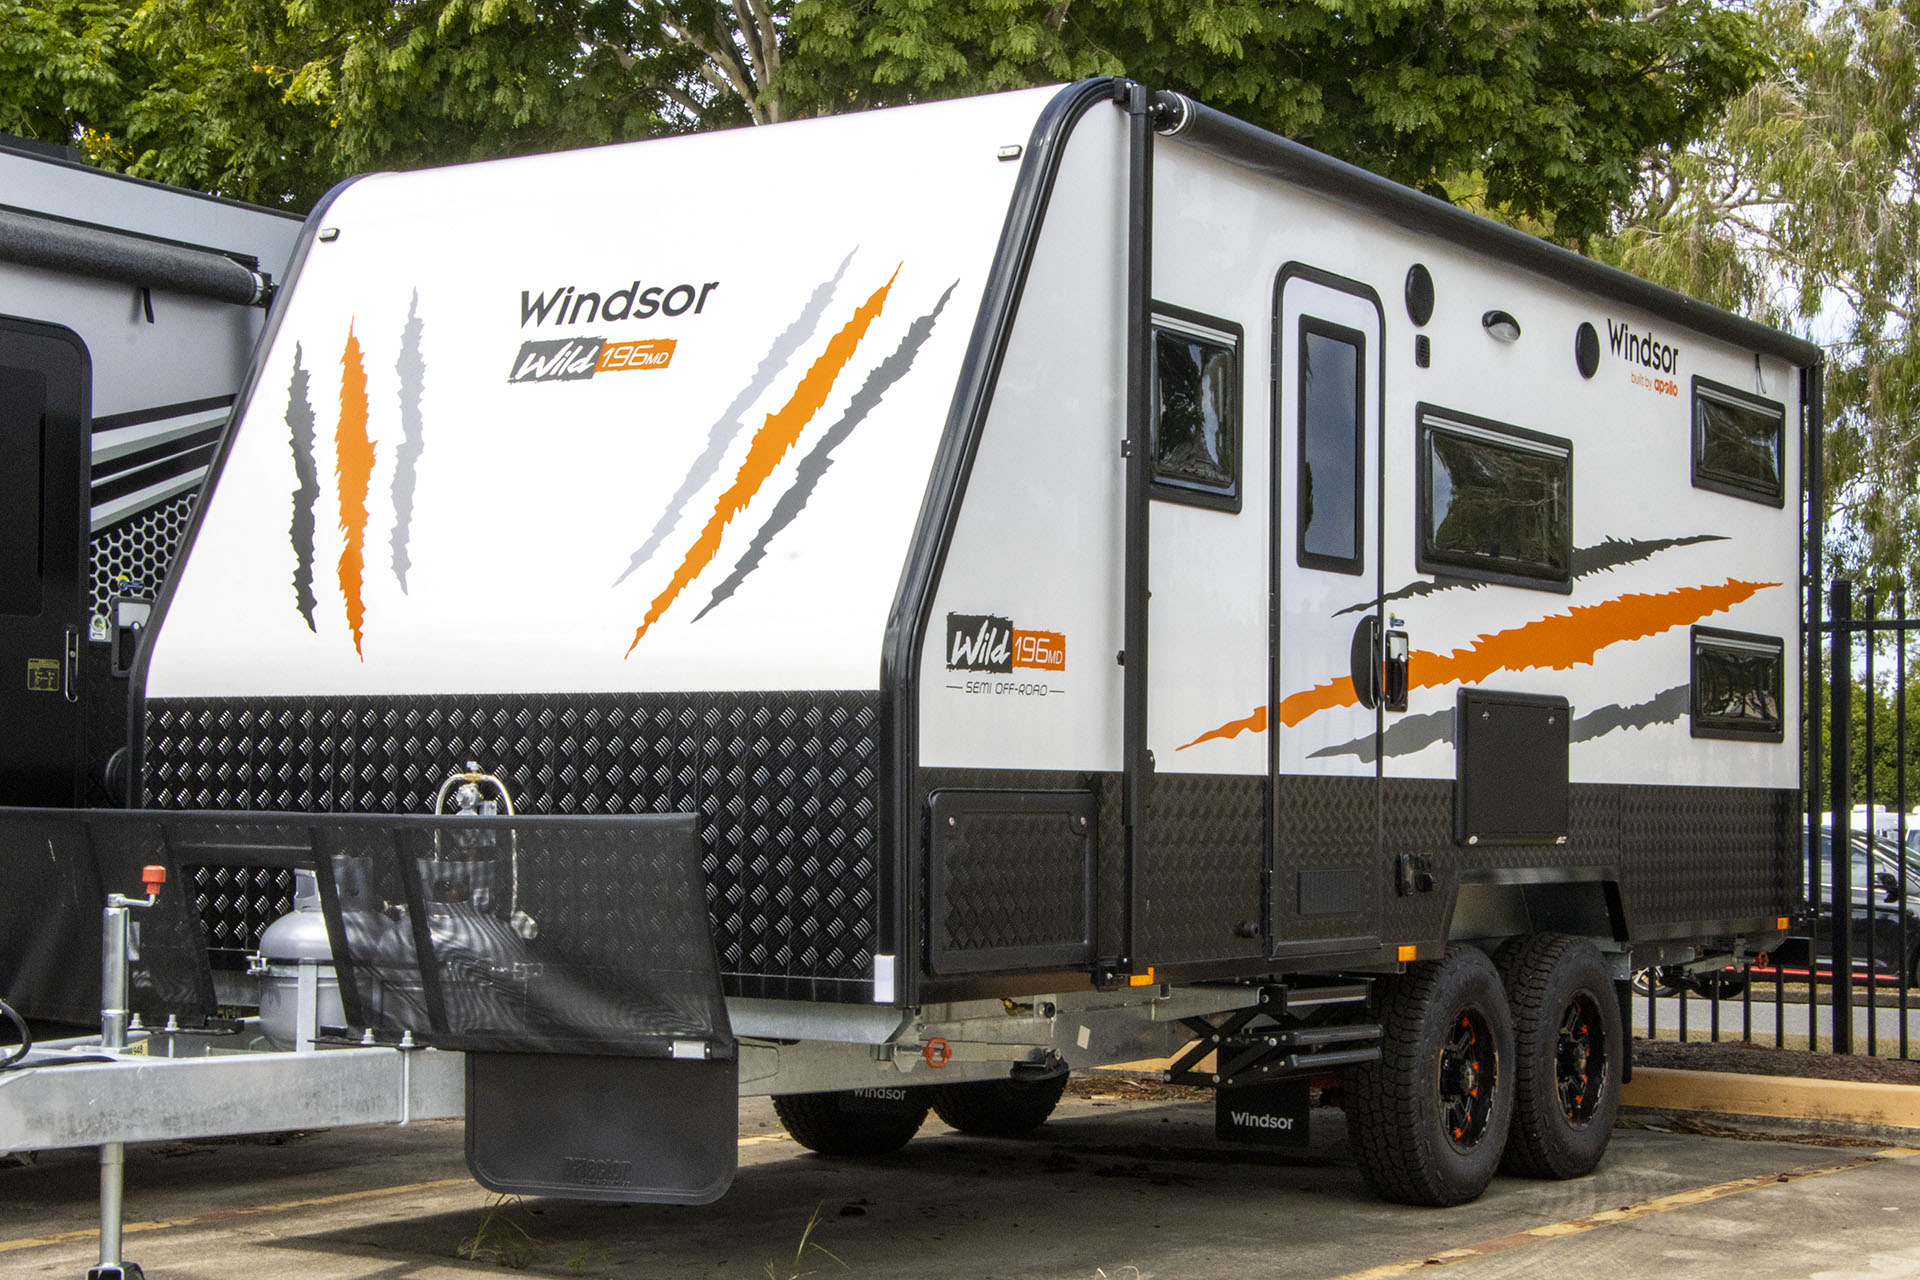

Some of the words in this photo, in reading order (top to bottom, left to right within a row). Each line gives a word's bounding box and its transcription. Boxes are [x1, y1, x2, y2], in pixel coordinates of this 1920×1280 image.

[521, 280, 720, 329] Windsor
[515, 341, 600, 380] Wild
[1607, 318, 1679, 375] Windsor
[1654, 378, 1678, 397] apollo
[951, 620, 1010, 666] Wild
[965, 681, 992, 694] SEMI
[995, 682, 1048, 696] OFF-ROAD
[1231, 1111, 1294, 1130] Windsor
